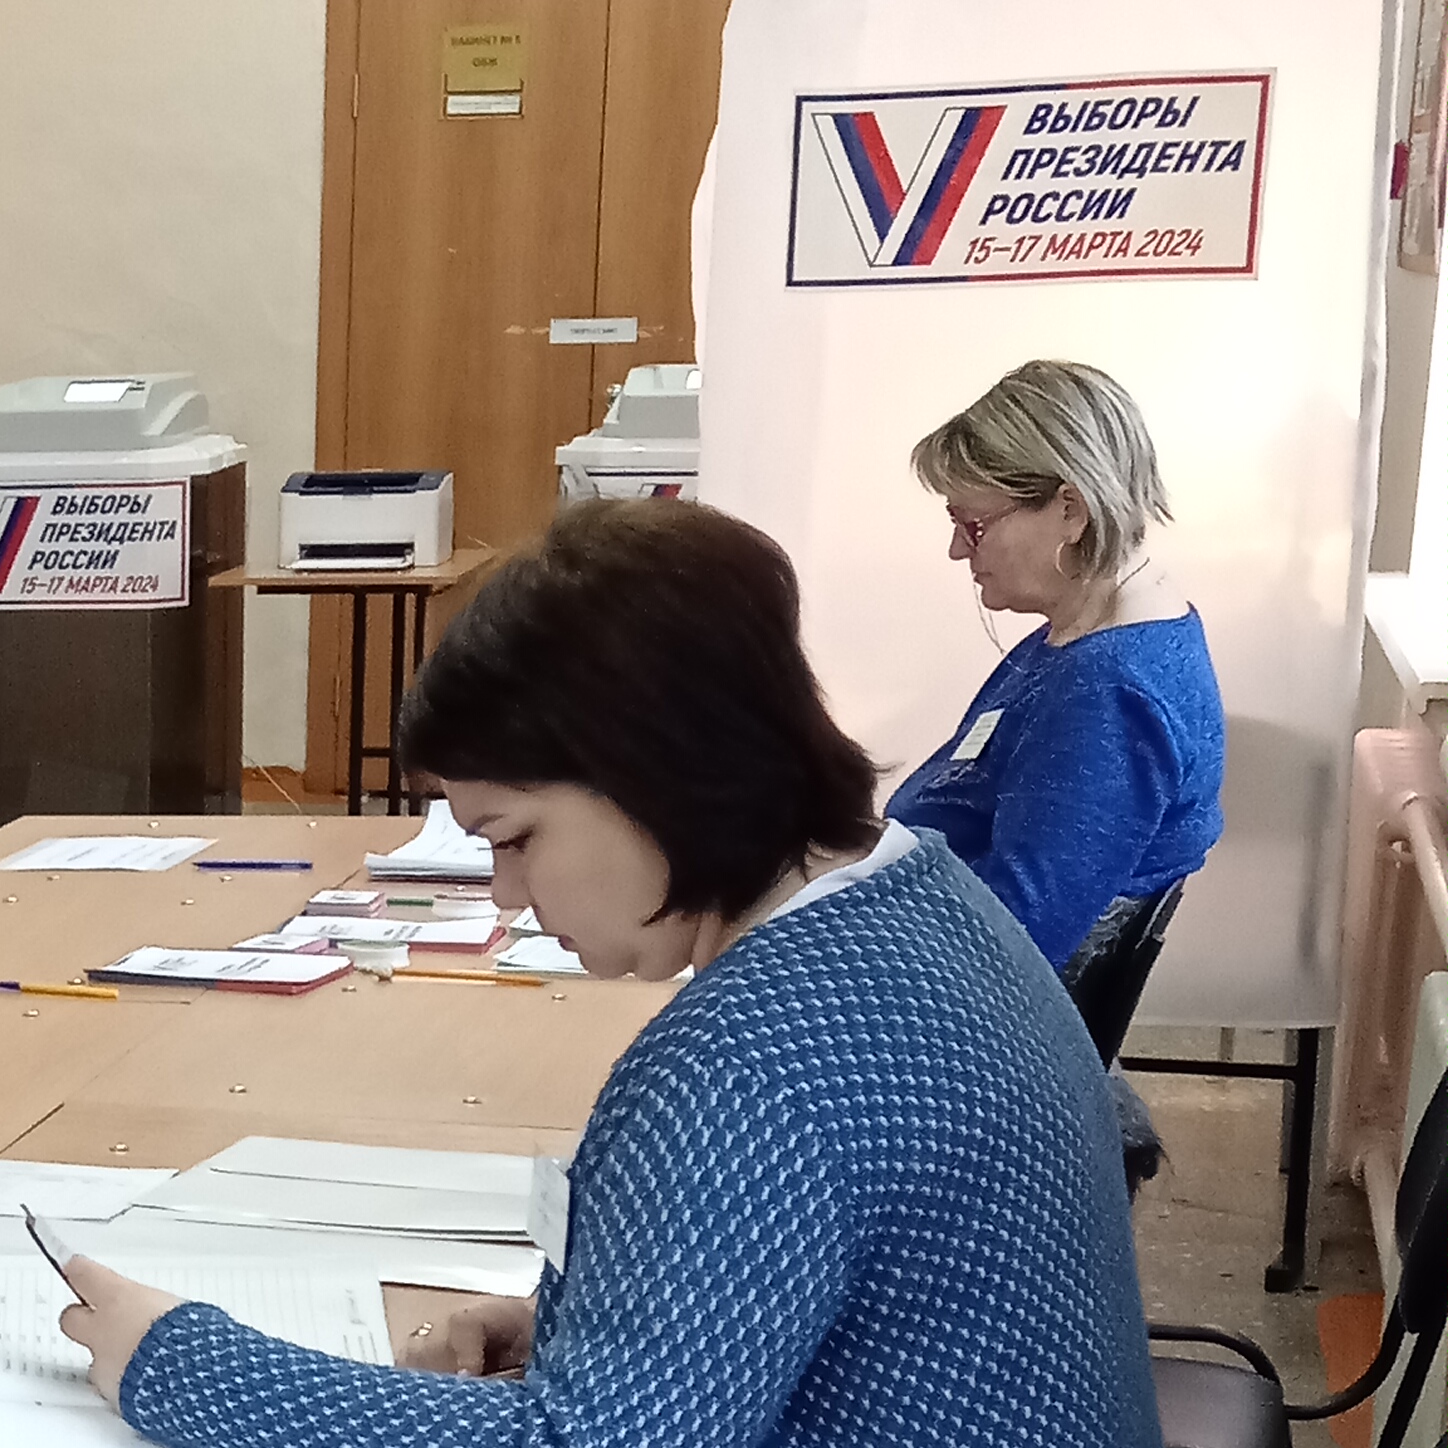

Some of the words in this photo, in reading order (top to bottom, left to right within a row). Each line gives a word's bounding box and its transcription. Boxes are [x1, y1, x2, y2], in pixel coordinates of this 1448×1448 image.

[1022, 95, 1201, 137] ВЫБОРЫ
[1000, 139, 1248, 182] ПРЕЗИДЕНТА
[978, 187, 1138, 227] РОССИИ
[1045, 231, 1133, 262] МАРТА
[1133, 227, 1206, 260] 2024
[50, 493, 153, 517] ВЫБОРЫ
[39, 519, 178, 546] ПРЕЗИДЕНТА
[27, 549, 120, 571] РОССИИ
[64, 575, 120, 595] МАРТА
[121, 574, 160, 594] 2024
